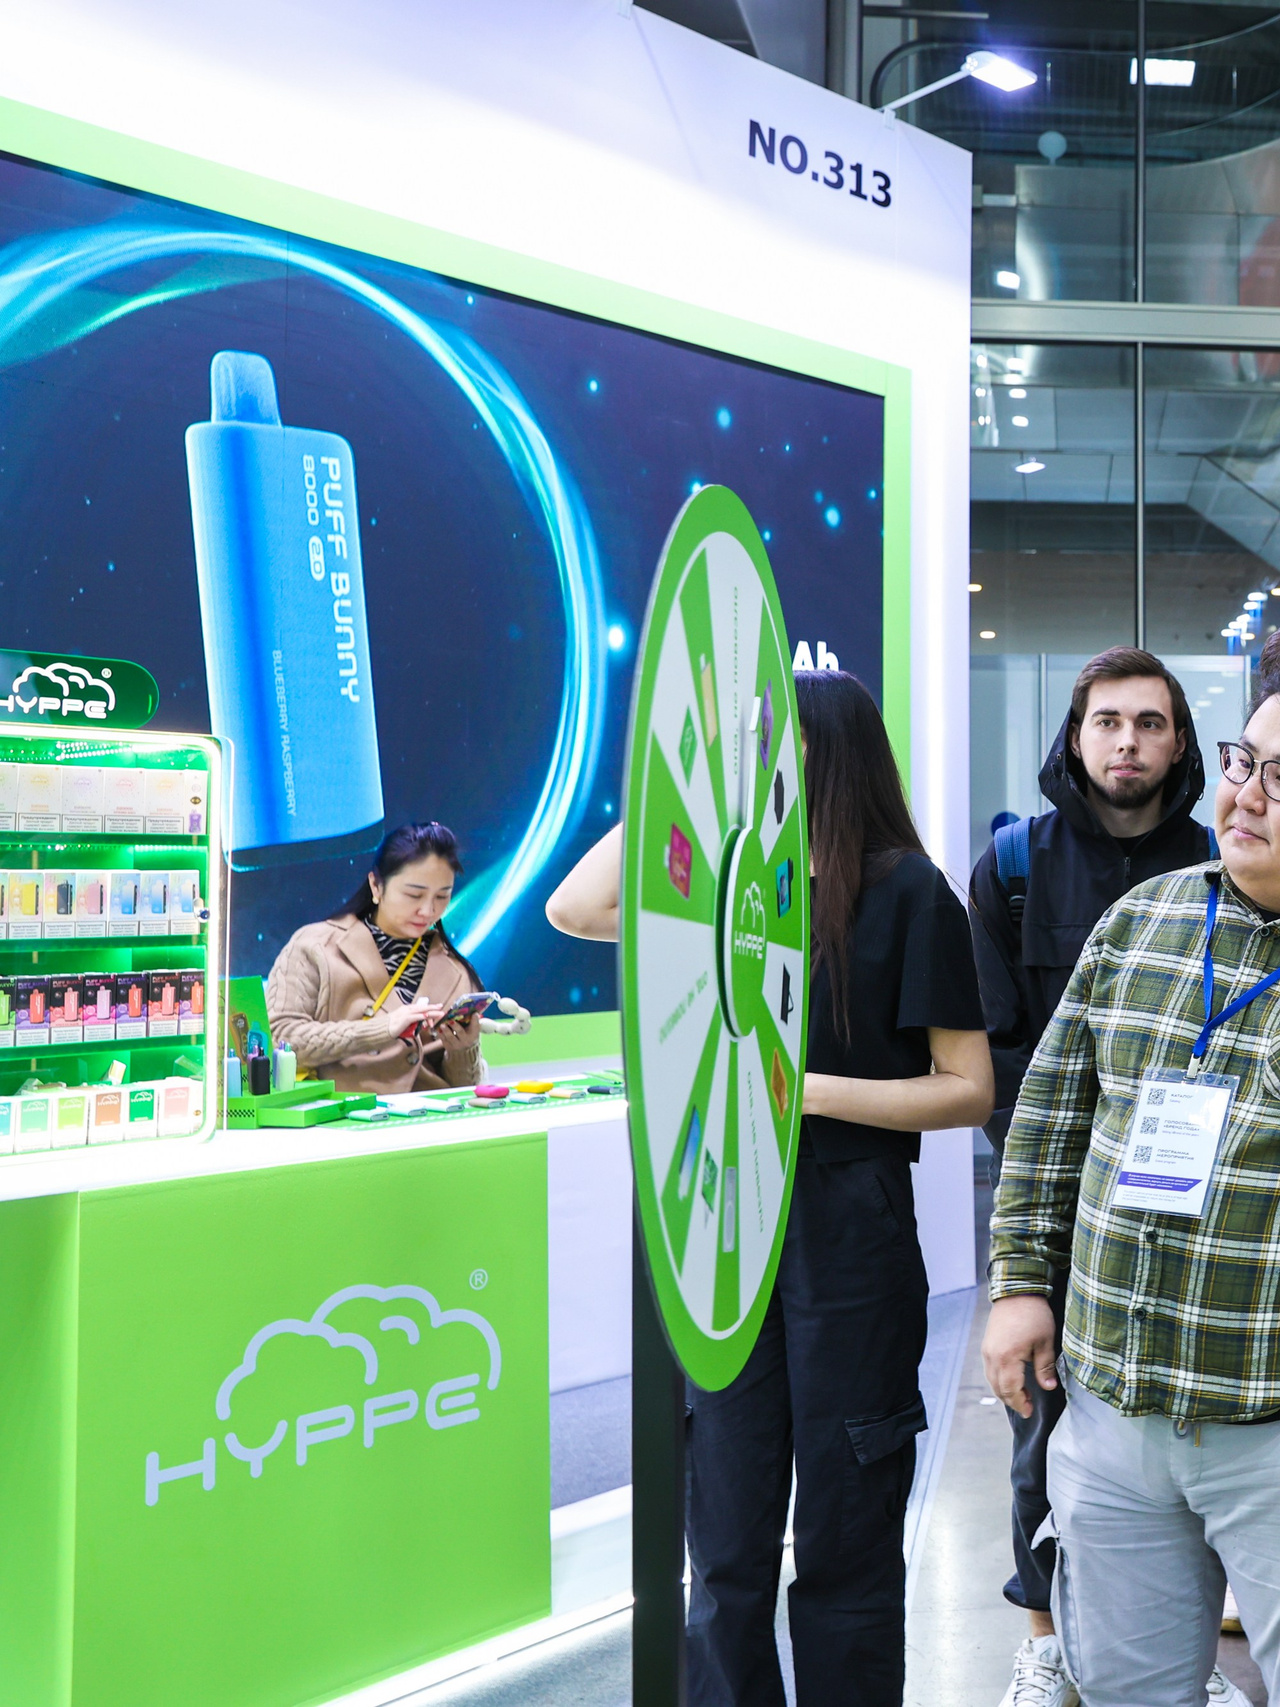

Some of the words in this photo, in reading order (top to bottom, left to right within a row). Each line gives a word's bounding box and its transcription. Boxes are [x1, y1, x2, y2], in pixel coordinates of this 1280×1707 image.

[749, 119, 892, 208] NO.313
[302, 454, 320, 526] 8000
[320, 456, 348, 560] PUFF
[330, 572, 361, 704] BUNNY
[272, 650, 289, 732] BLUEBERRY
[281, 734, 297, 817] RASPBERRY
[734, 930, 763, 959] HYPPE
[145, 1373, 481, 1507] HYPPE
